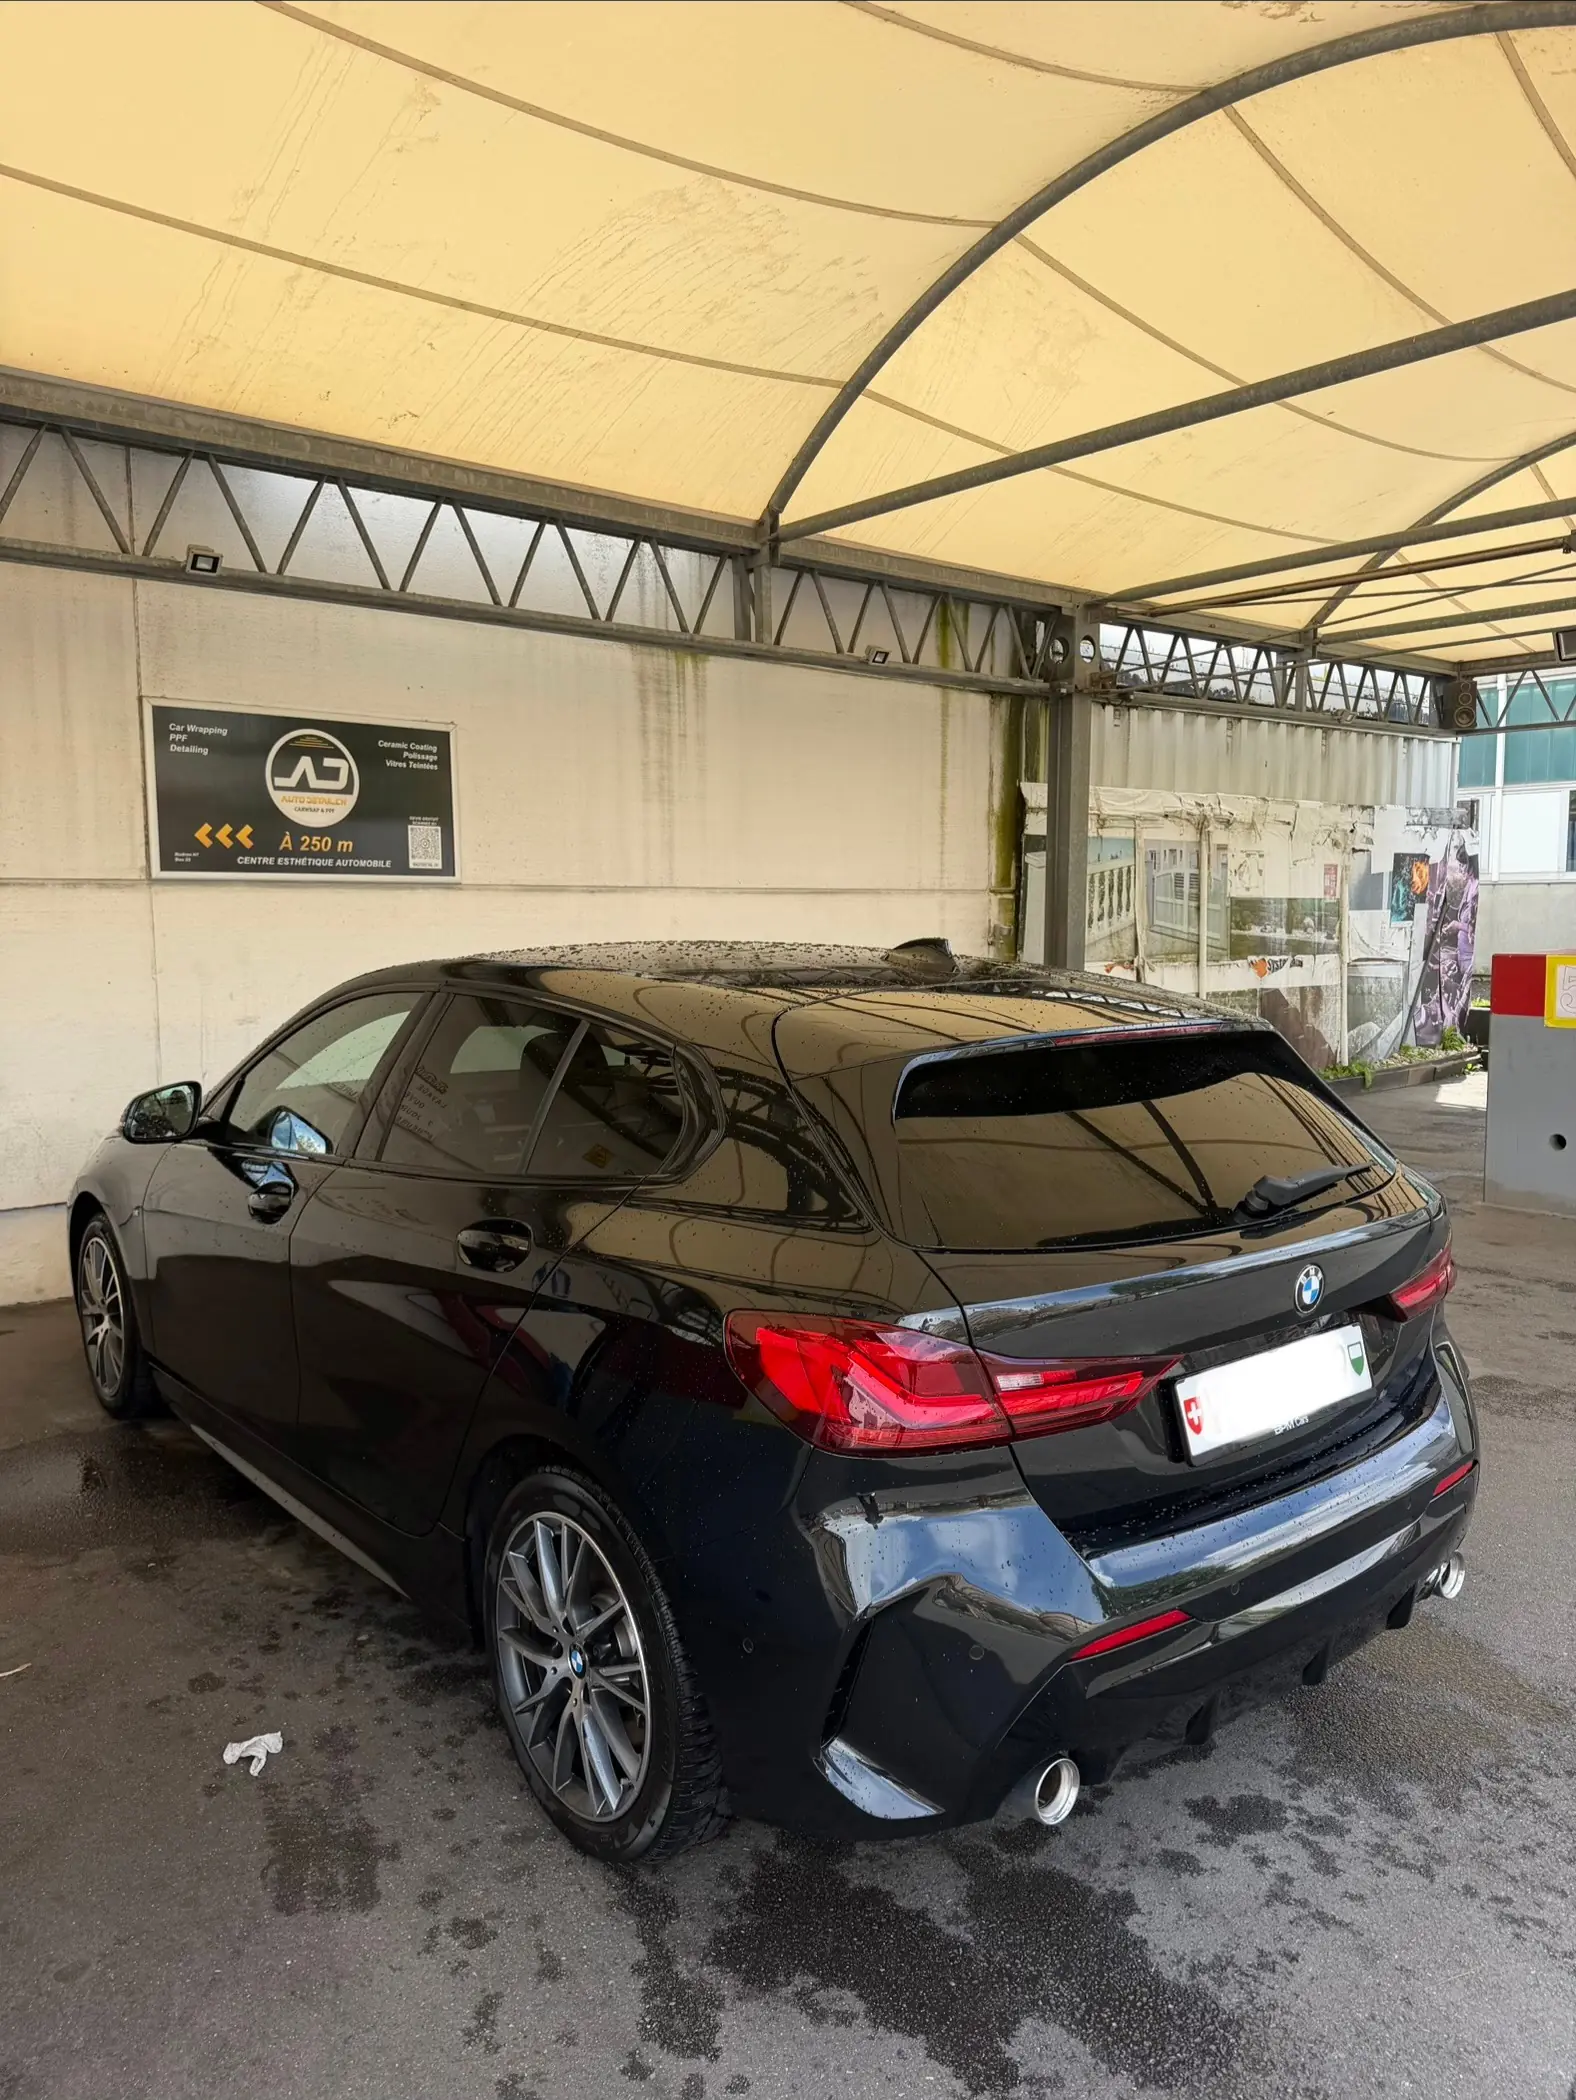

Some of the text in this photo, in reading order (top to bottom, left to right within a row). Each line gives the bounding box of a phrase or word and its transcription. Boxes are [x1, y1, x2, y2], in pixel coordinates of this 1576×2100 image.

[169, 723, 228, 736] Car Wrapping
[169, 733, 188, 742] PPF
[170, 744, 209, 756] Detailing
[378, 740, 437, 753] Ceramic Coating
[403, 751, 438, 763] Polissage
[385, 759, 407, 768] Vitres
[279, 831, 353, 853] À 250 m
[237, 856, 392, 868] CENTRE ESTHÉTIQUE AUTOMOBILE
